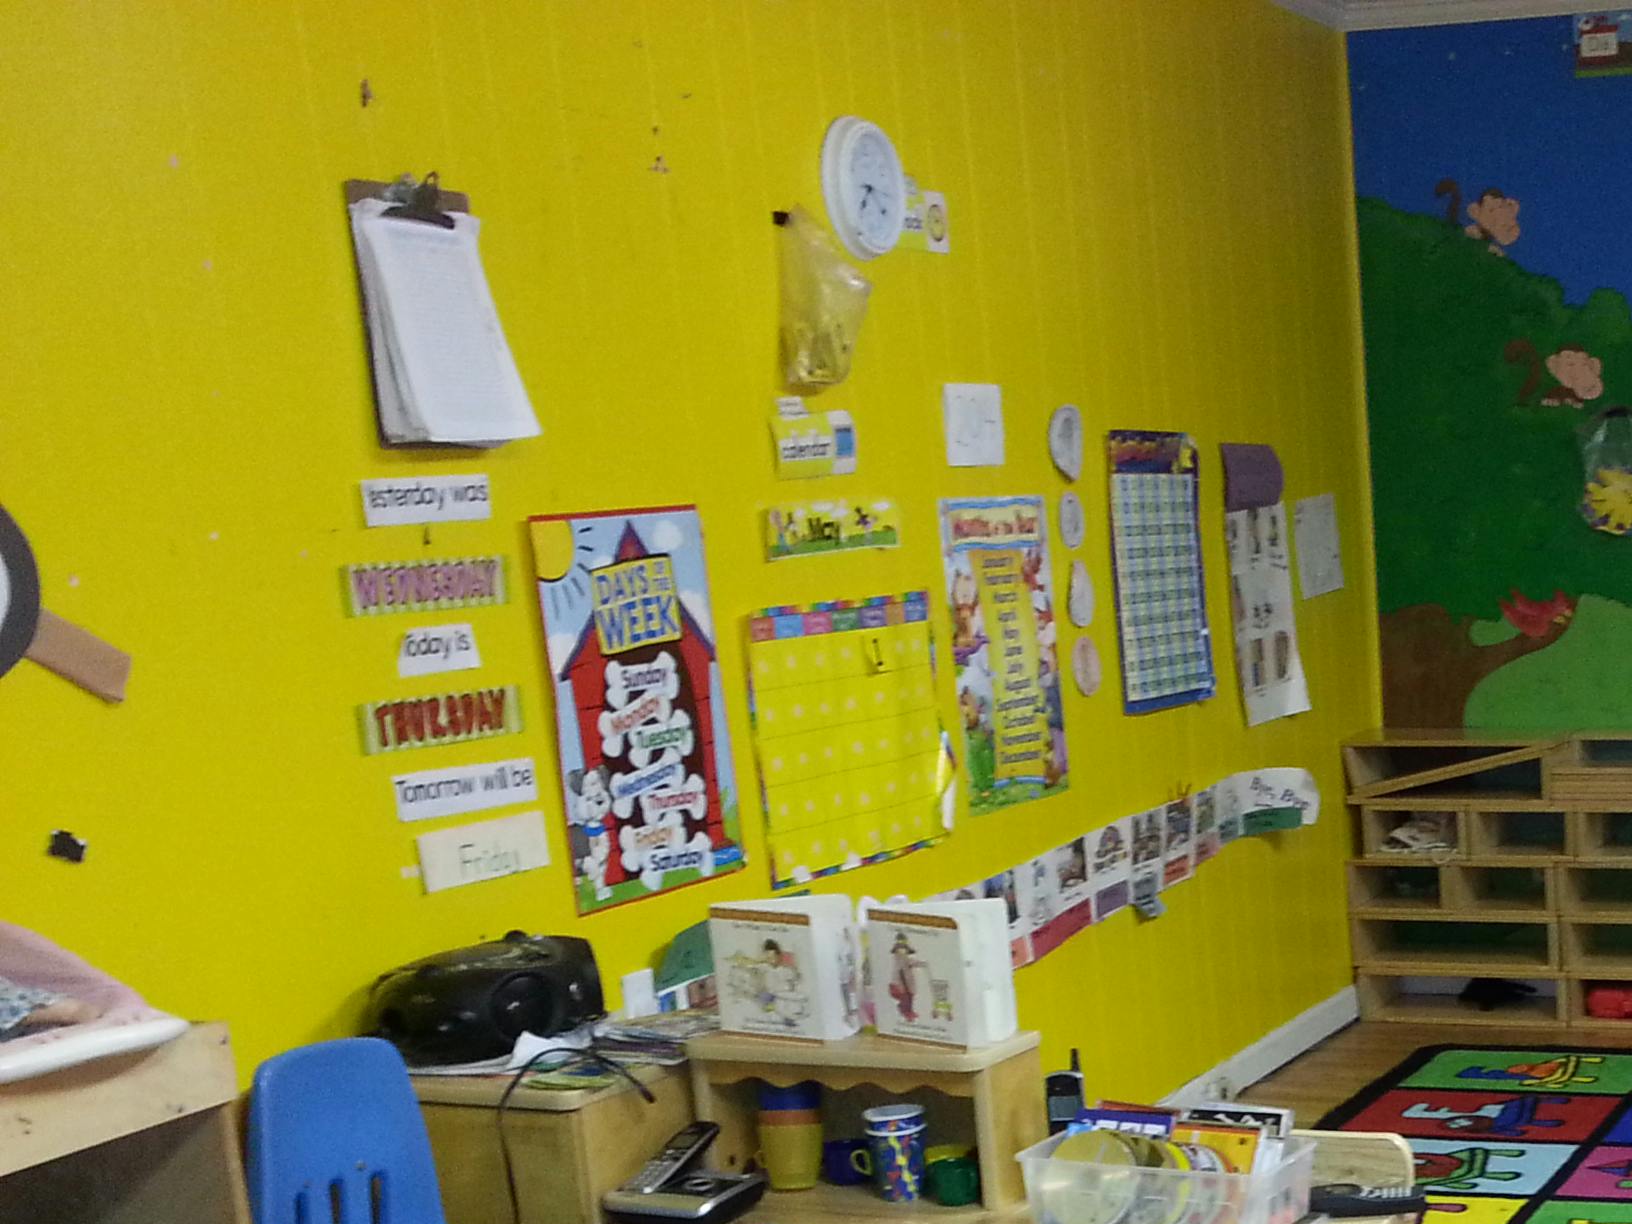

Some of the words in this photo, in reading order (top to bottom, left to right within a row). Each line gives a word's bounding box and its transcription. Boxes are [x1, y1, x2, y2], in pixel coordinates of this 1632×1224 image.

[455, 484, 488, 503] was
[352, 558, 498, 609] WEDNESDAY
[596, 564, 649, 606] DAYS
[595, 595, 679, 650] WEEK
[405, 633, 450, 659] Today
[455, 630, 471, 651] is
[621, 667, 667, 689] Sunday
[375, 687, 506, 748] THURSDAY
[636, 727, 687, 748] Tuesday
[395, 776, 476, 803] Tomorrow
[480, 766, 508, 790] will
[511, 765, 533, 788] be
[648, 790, 699, 810] Thursday
[650, 851, 704, 872] Saturday
